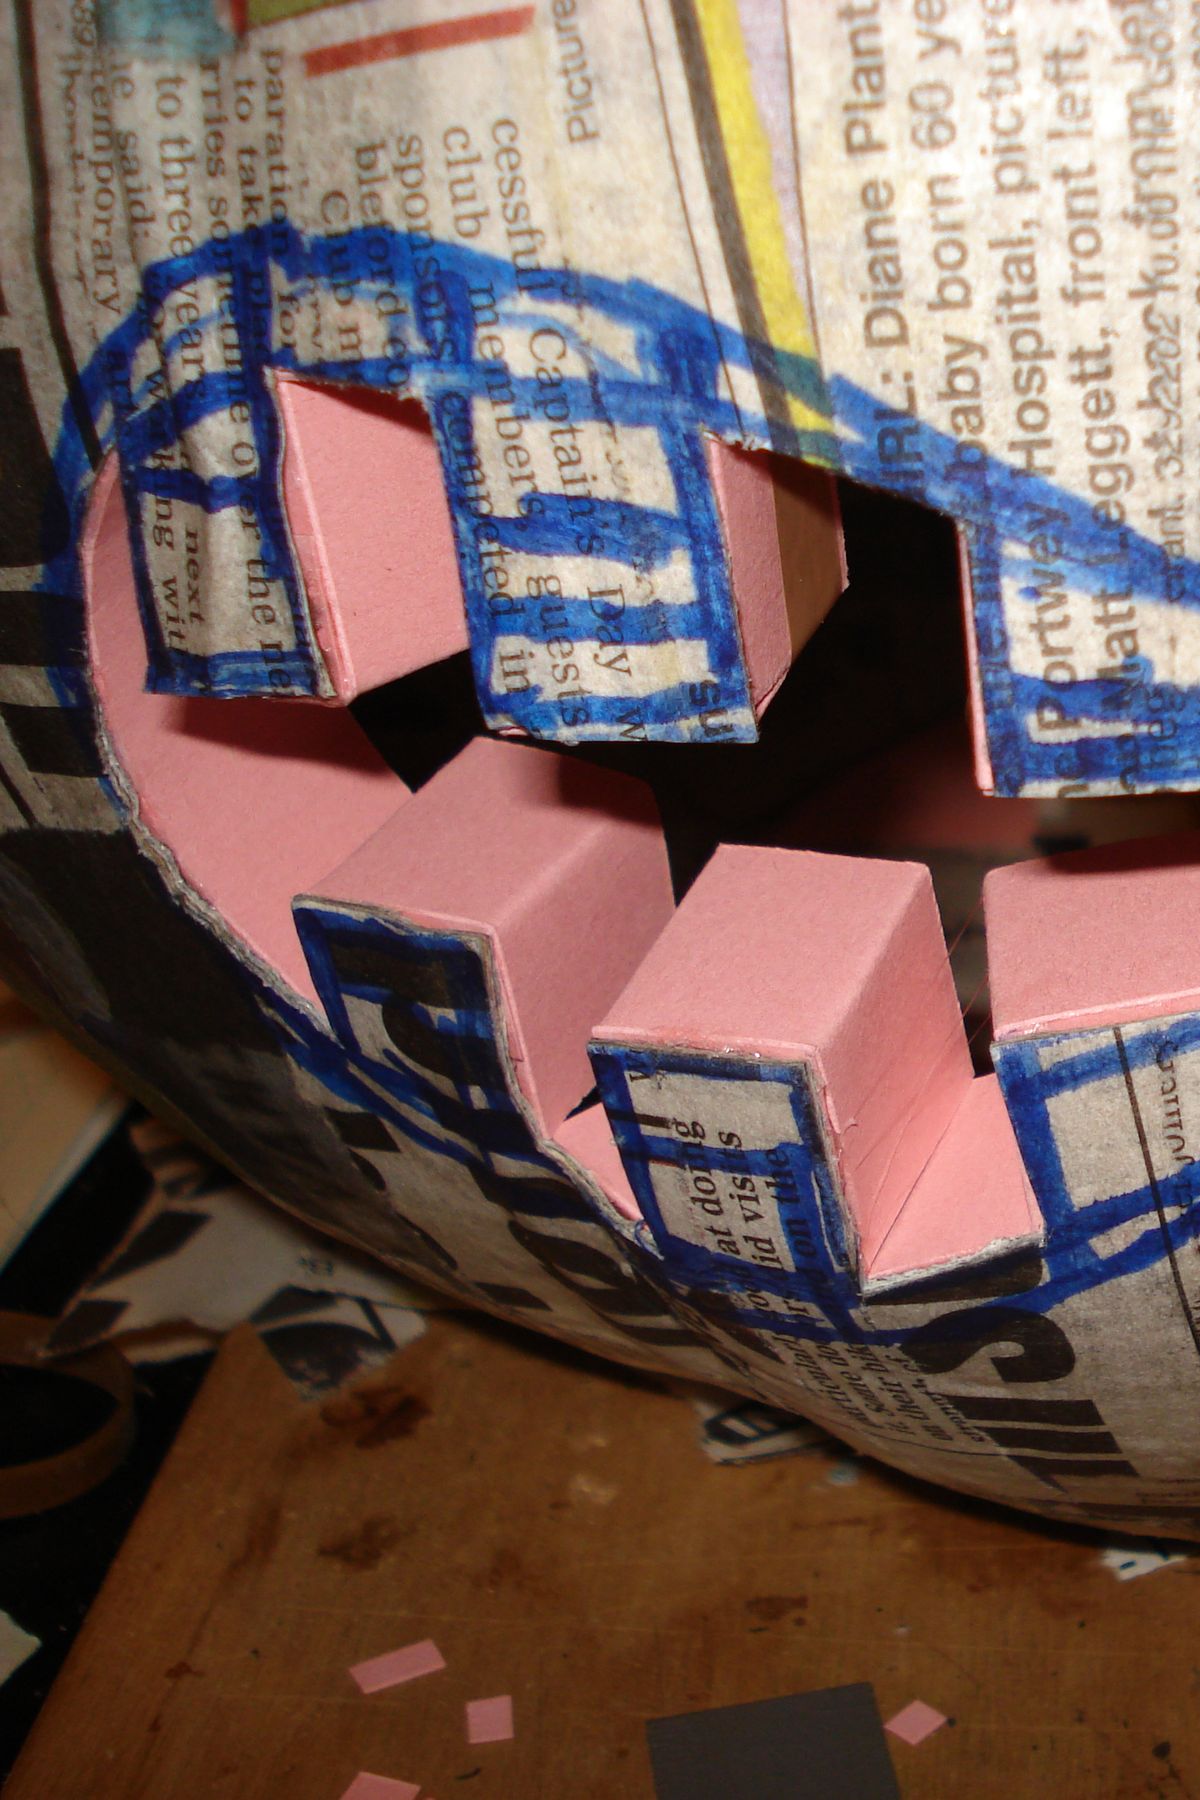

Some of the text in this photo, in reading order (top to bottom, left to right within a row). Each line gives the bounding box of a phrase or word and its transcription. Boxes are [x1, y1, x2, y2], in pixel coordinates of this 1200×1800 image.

[154, 75, 187, 120] to
[234, 78, 261, 122] to
[907, 80, 957, 151] 60
[1042, 28, 1095, 142] left,
[158, 136, 197, 257] three
[320, 189, 362, 304] Club
[924, 174, 973, 313] born
[1051, 162, 1106, 308] front
[857, 179, 910, 348] Diane
[490, 118, 546, 294] cessful
[585, 586, 633, 679] Day
[937, 333, 990, 472] baby
[988, 220, 1058, 478] Hospital,
[442, 125, 490, 240] club
[526, 575, 592, 730] guests
[244, 559, 280, 626] the
[441, 391, 527, 618] competed
[498, 649, 536, 695] in
[1022, 501, 1079, 732] Portwey
[1090, 586, 1144, 712] Matt
[667, 1117, 741, 1256] at doing
[717, 1130, 767, 1224] visits
[762, 1147, 800, 1207] the
[786, 1217, 817, 1260] on
